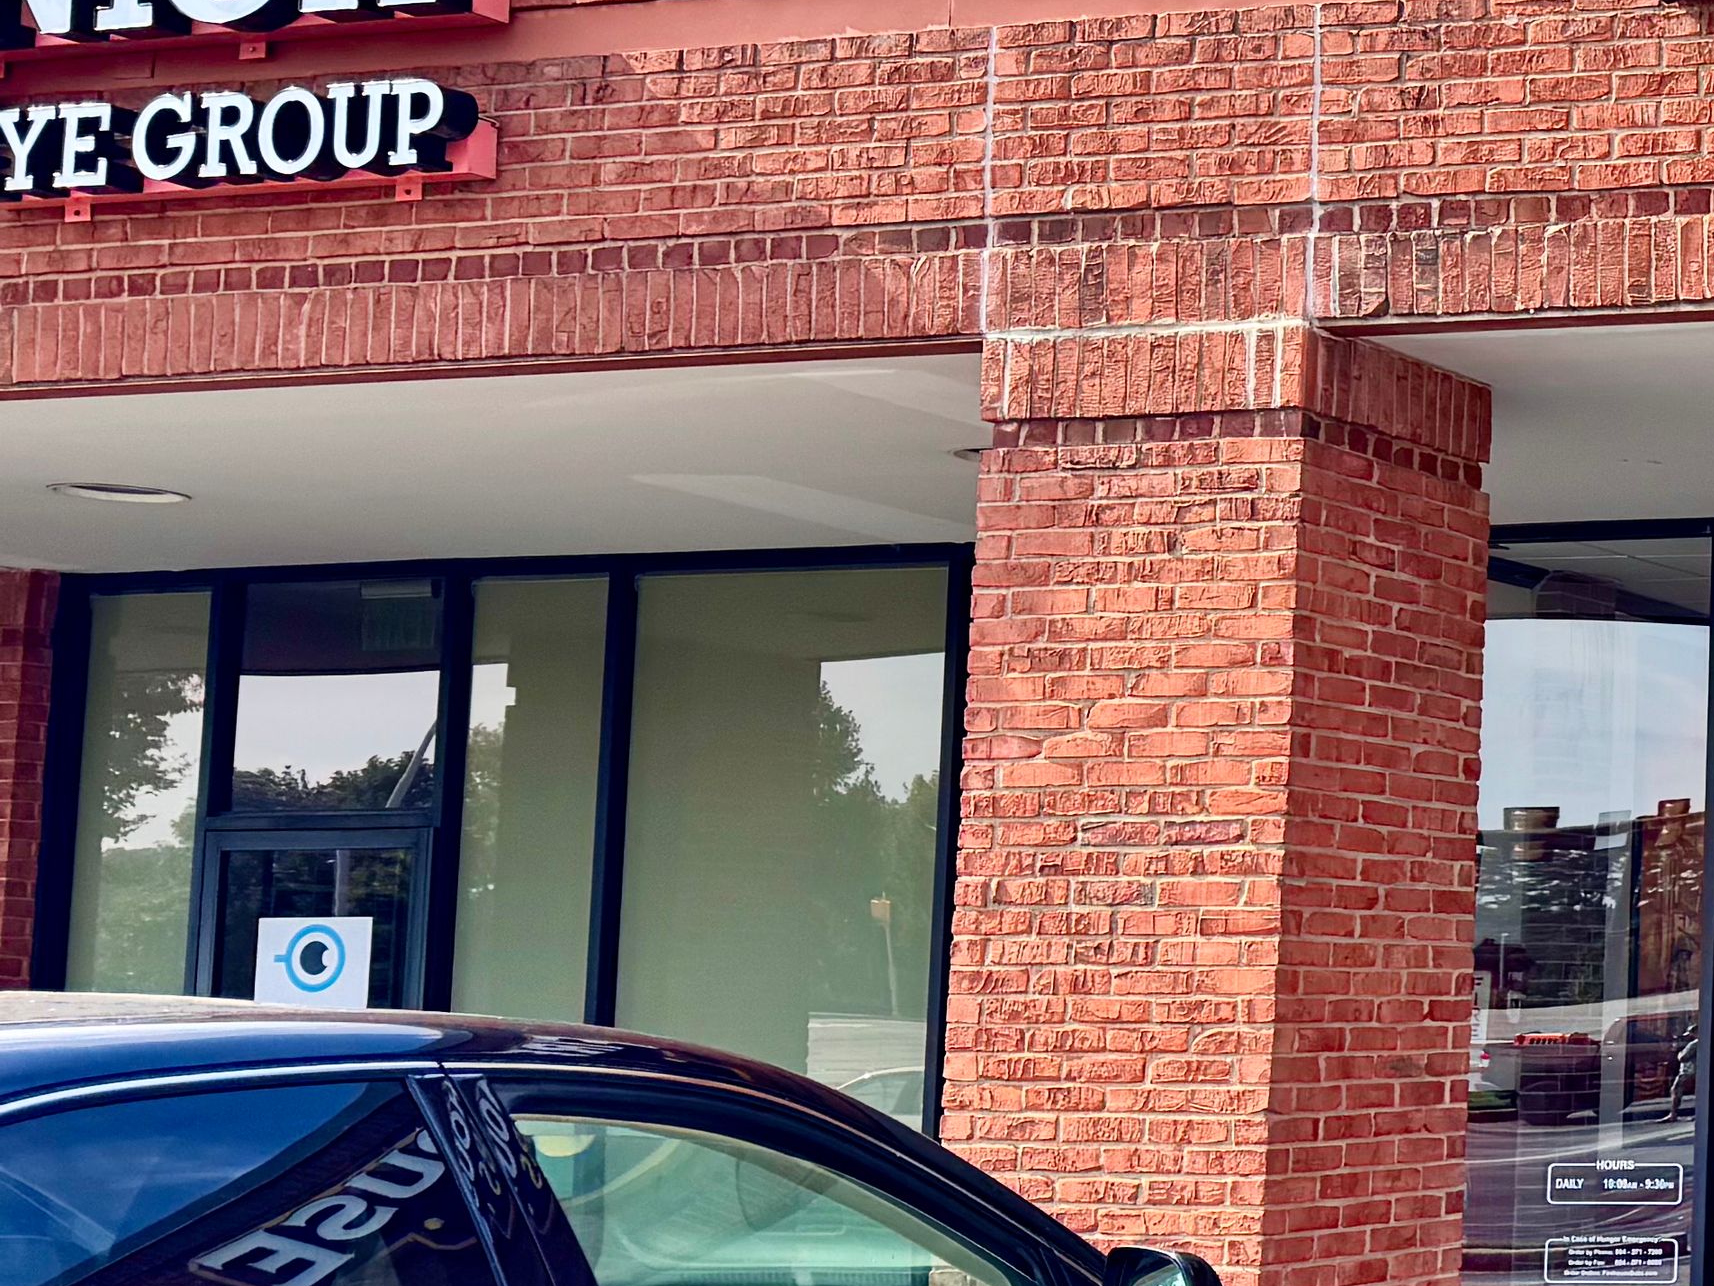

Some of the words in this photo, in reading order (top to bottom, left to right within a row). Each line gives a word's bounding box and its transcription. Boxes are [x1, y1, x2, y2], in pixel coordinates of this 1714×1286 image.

[132, 78, 444, 182] GROUP
[1596, 1160, 1635, 1170] HOURS
[1555, 1178, 1584, 1189] DAILY
